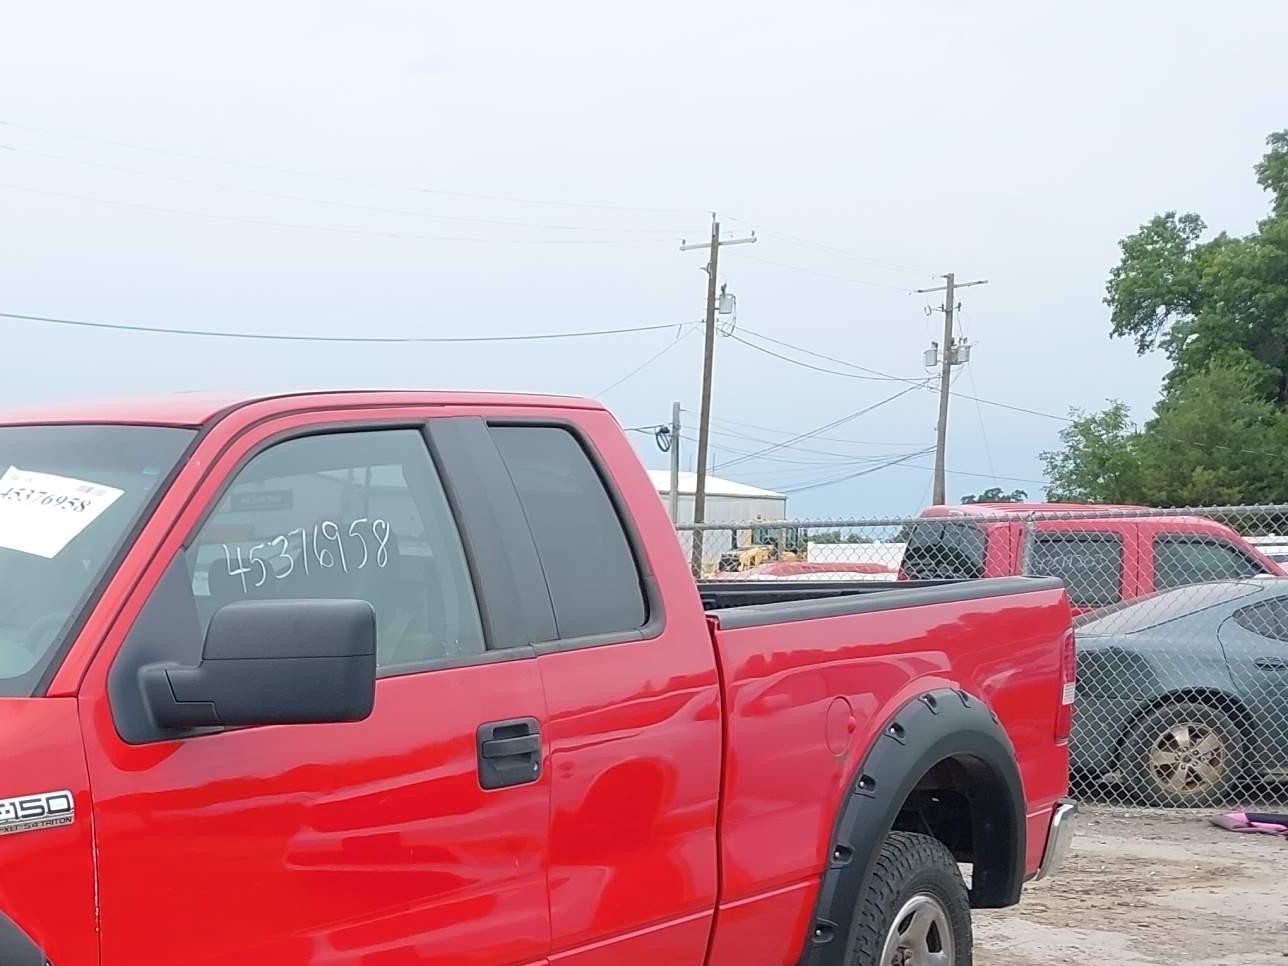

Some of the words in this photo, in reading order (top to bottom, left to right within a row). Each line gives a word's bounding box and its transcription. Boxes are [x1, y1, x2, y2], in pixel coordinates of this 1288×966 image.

[0, 486, 92, 514] 45376958
[222, 518, 390, 593] 45376958
[39, 816, 73, 828] TRITON
